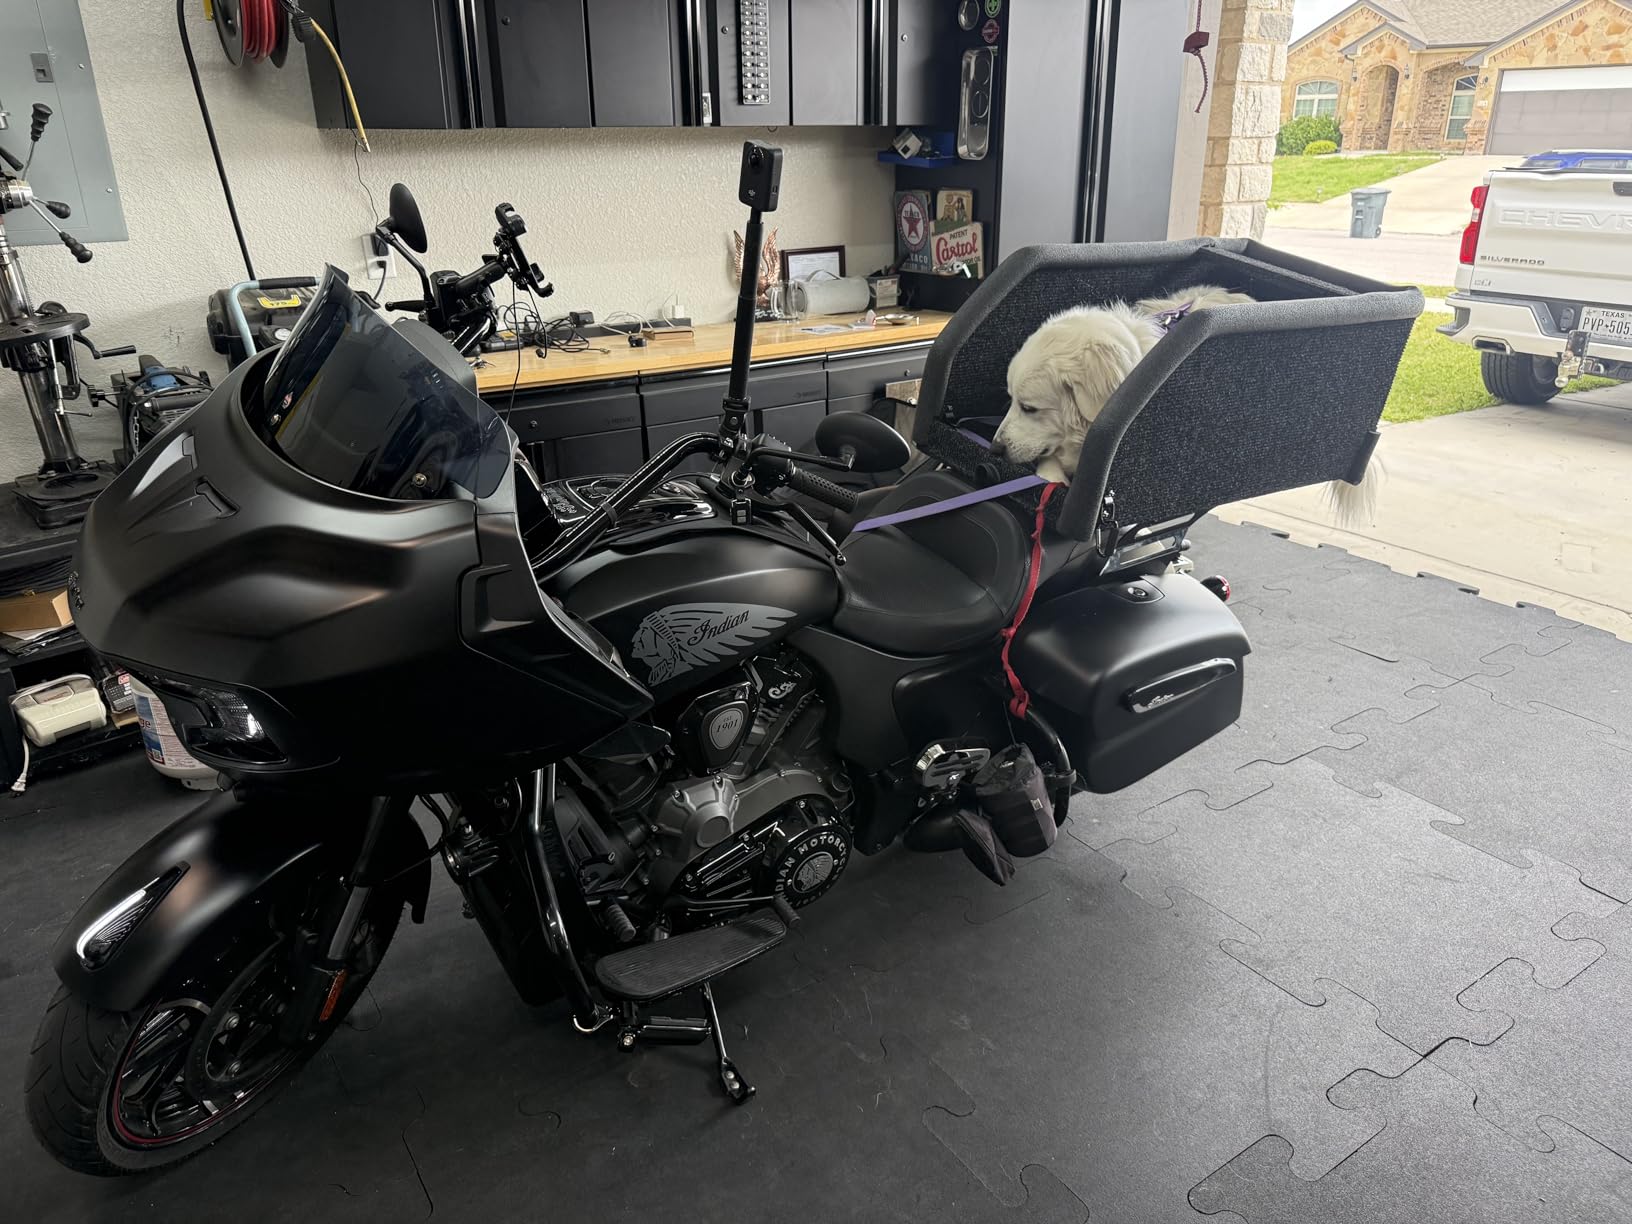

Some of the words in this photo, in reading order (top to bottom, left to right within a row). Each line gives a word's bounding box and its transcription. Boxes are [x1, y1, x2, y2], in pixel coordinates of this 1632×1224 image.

[949, 229, 968, 240] PATENT
[935, 232, 978, 264] Castrol
[1480, 255, 1546, 266] SILVERADO
[1601, 310, 1626, 319] TEXAS
[686, 609, 750, 647] Indian
[717, 718, 739, 733] 1901
